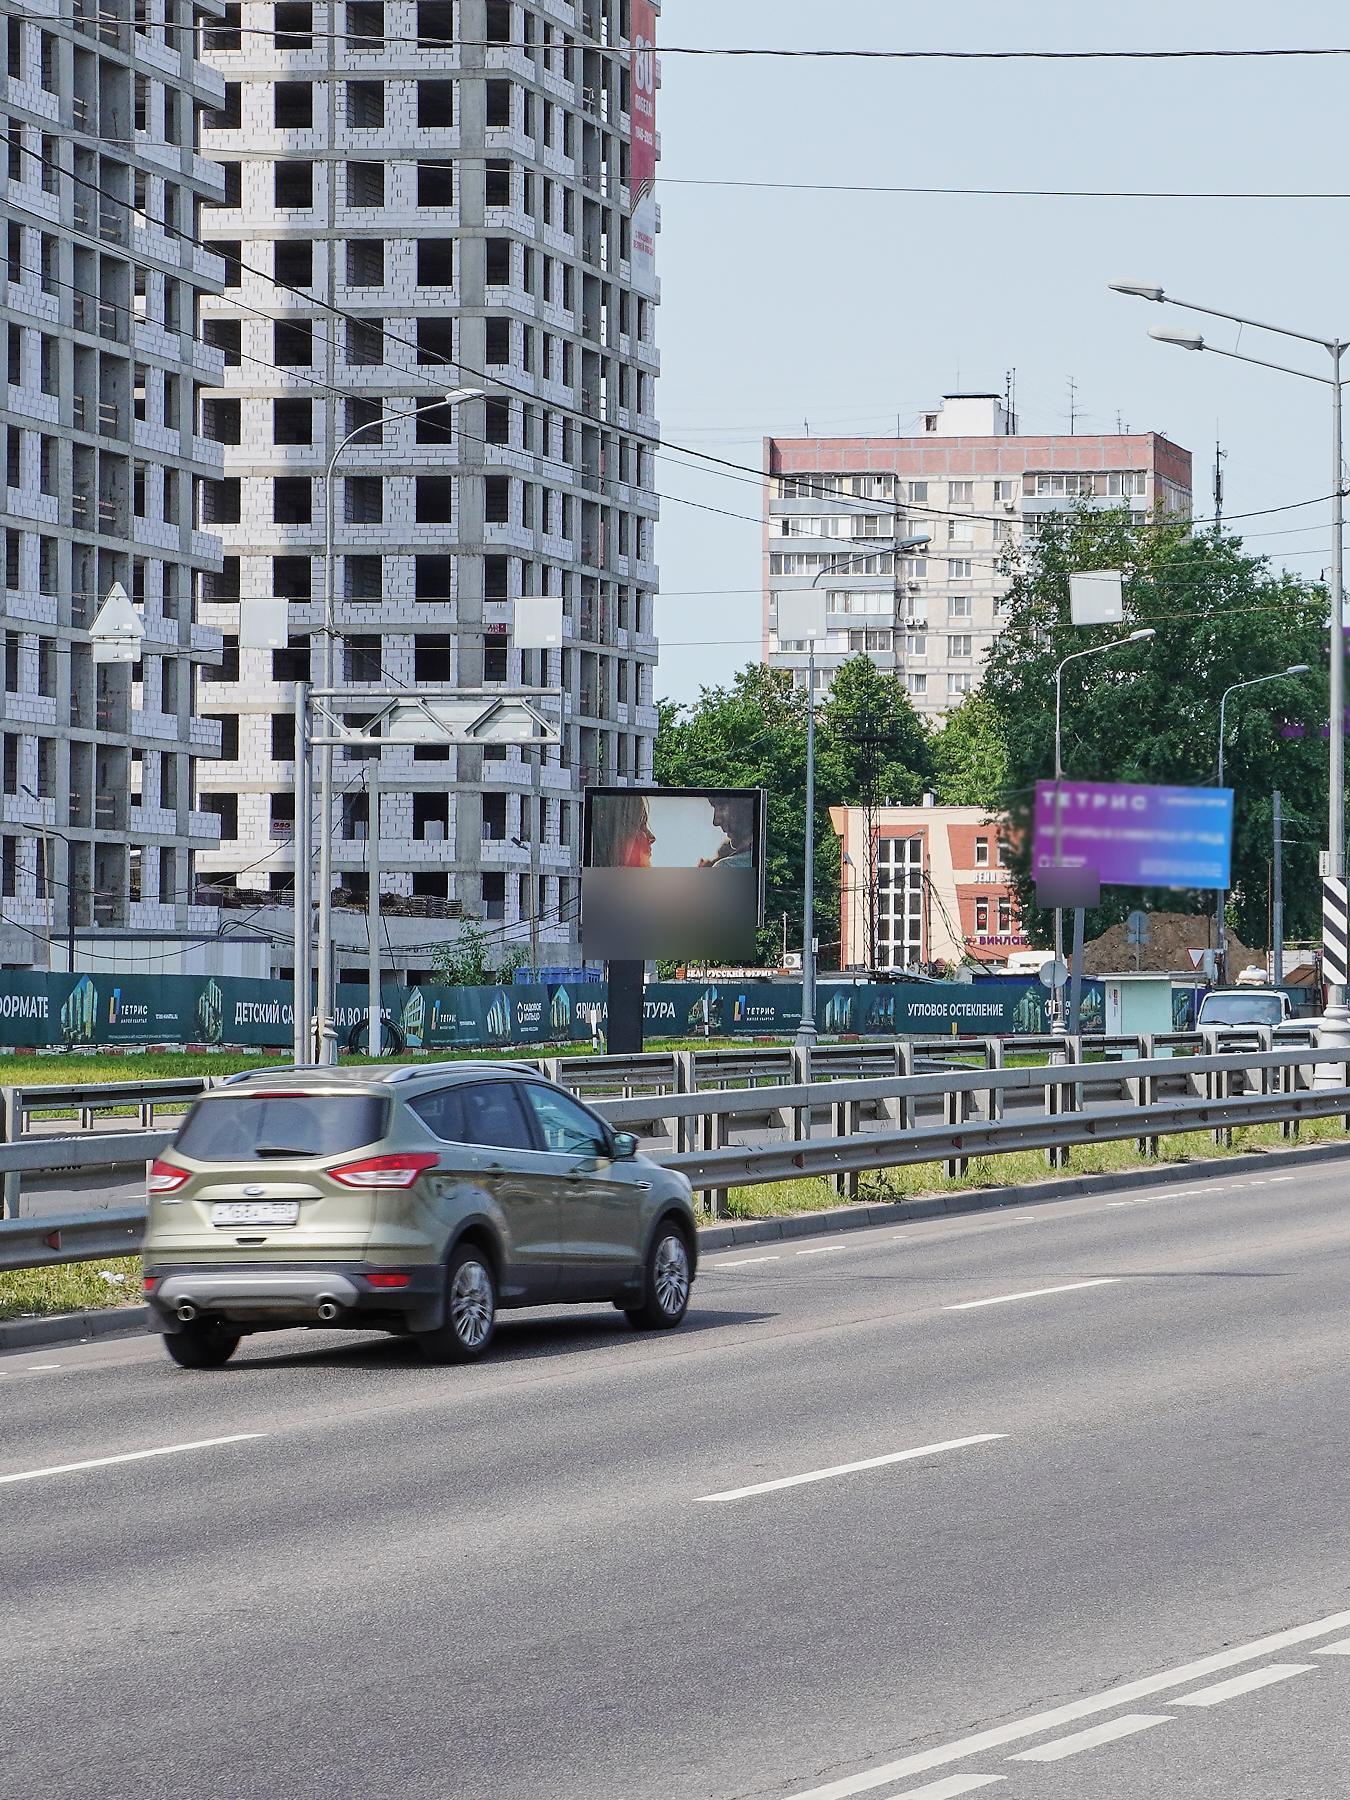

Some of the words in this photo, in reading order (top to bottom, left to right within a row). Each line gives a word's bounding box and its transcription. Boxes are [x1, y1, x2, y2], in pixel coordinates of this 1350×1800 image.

[635, 35, 653, 95] 80
[121, 1004, 148, 1015] ТЕТРИС
[234, 1000, 281, 1025] ДЕТСКИЙ
[281, 1004, 294, 1025] СА
[747, 1007, 775, 1015] ТЕТРИС
[907, 1003, 948, 1017] УГЛОВОЕ
[949, 1003, 1004, 1017] ОСТЕКЛЕНИЕ
